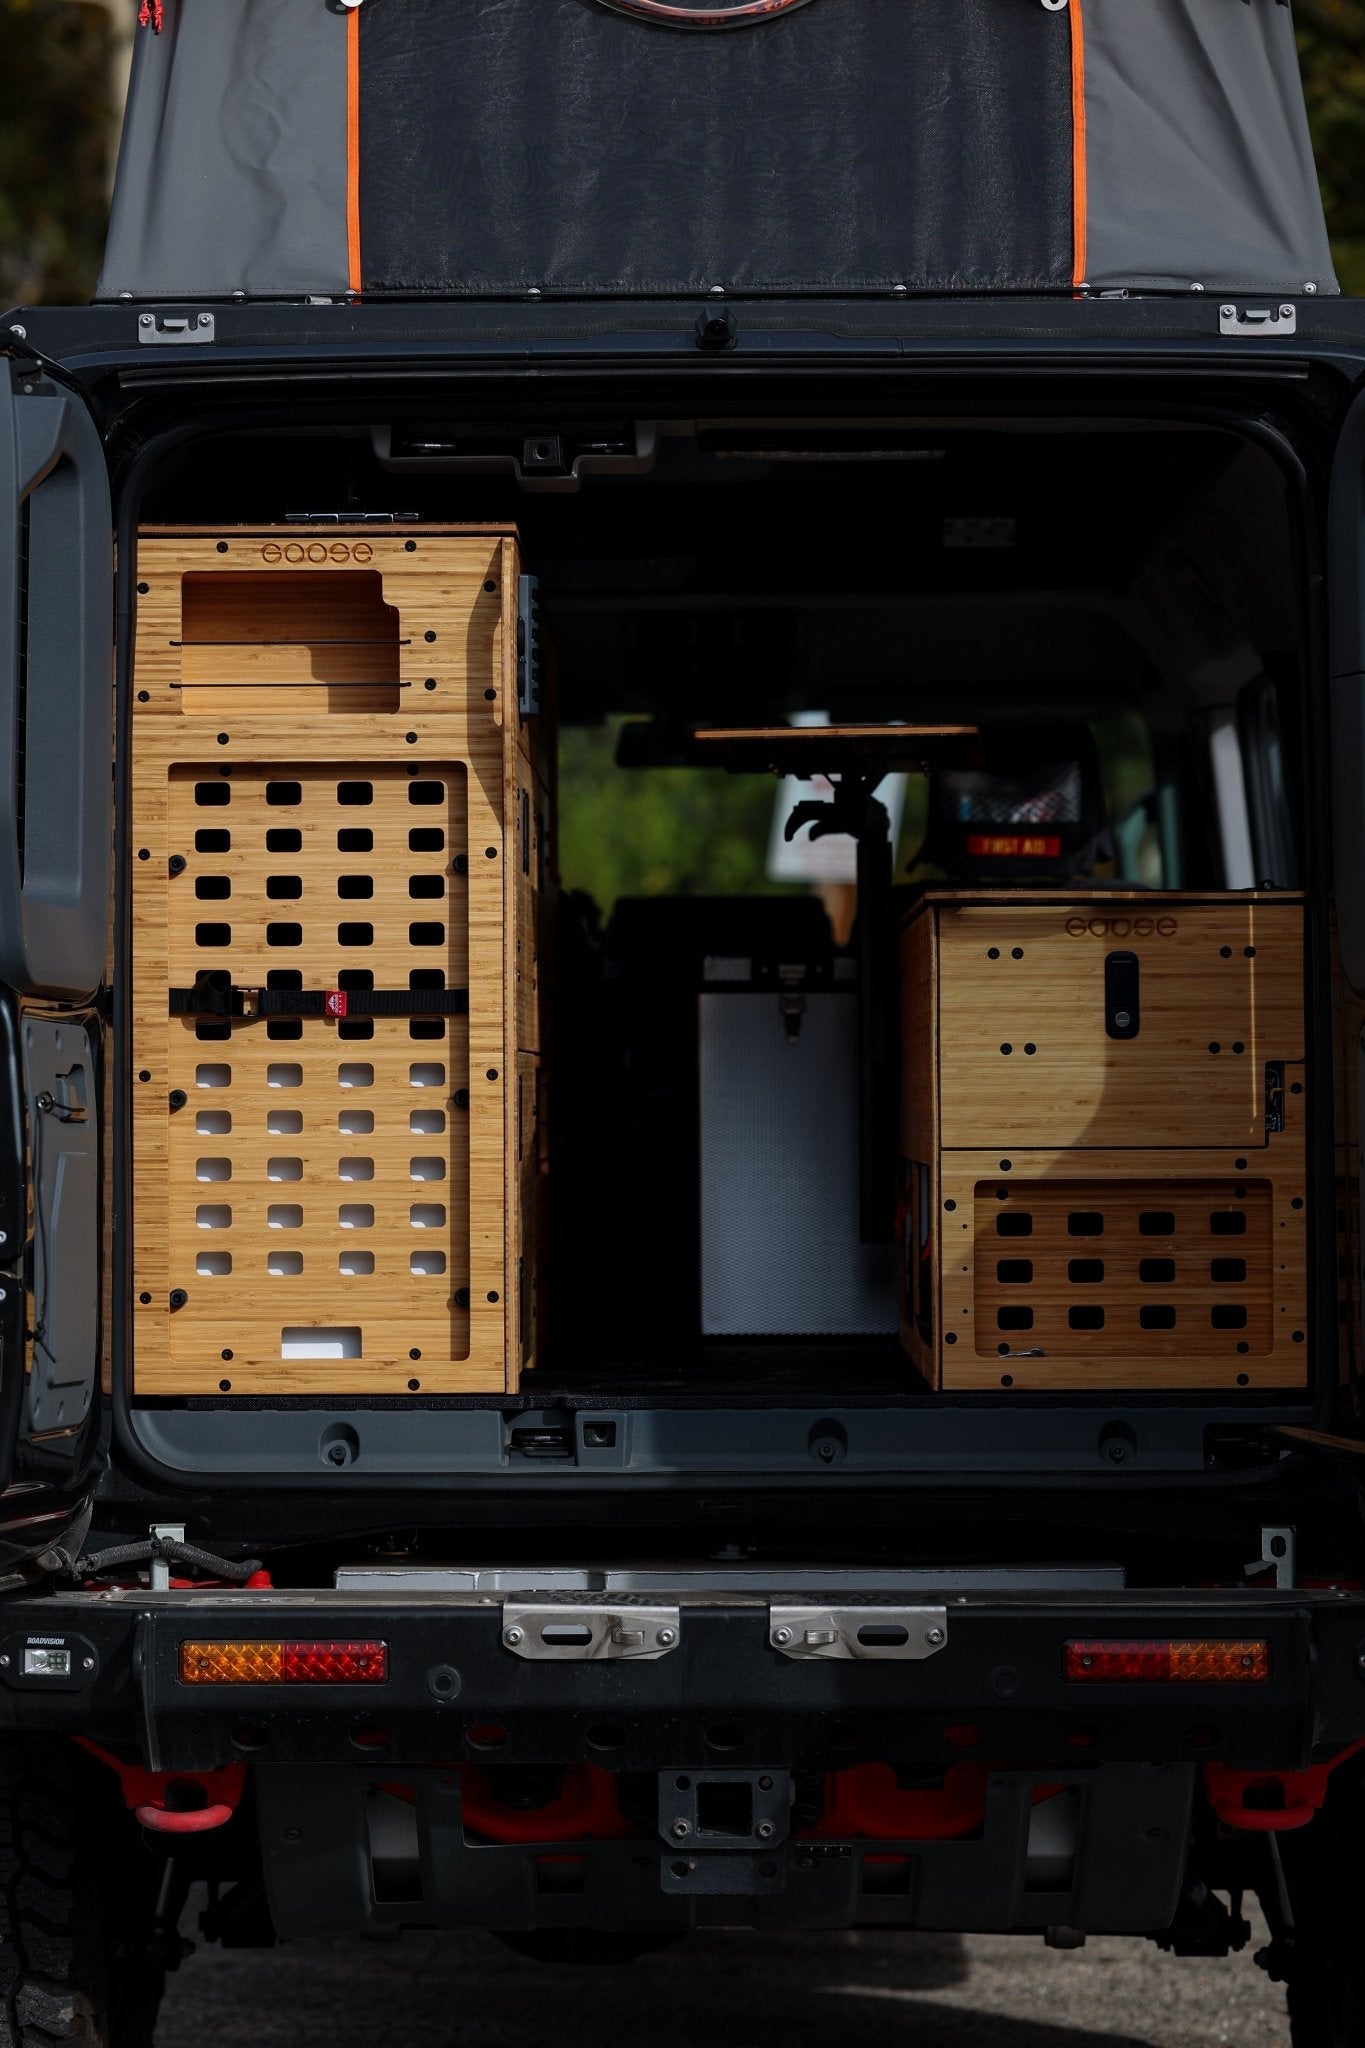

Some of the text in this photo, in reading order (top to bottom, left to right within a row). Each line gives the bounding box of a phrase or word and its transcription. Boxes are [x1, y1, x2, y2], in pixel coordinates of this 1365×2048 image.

[982, 838, 1046, 855] FIRST AID
[26, 1637, 65, 1646] ROADVISION
